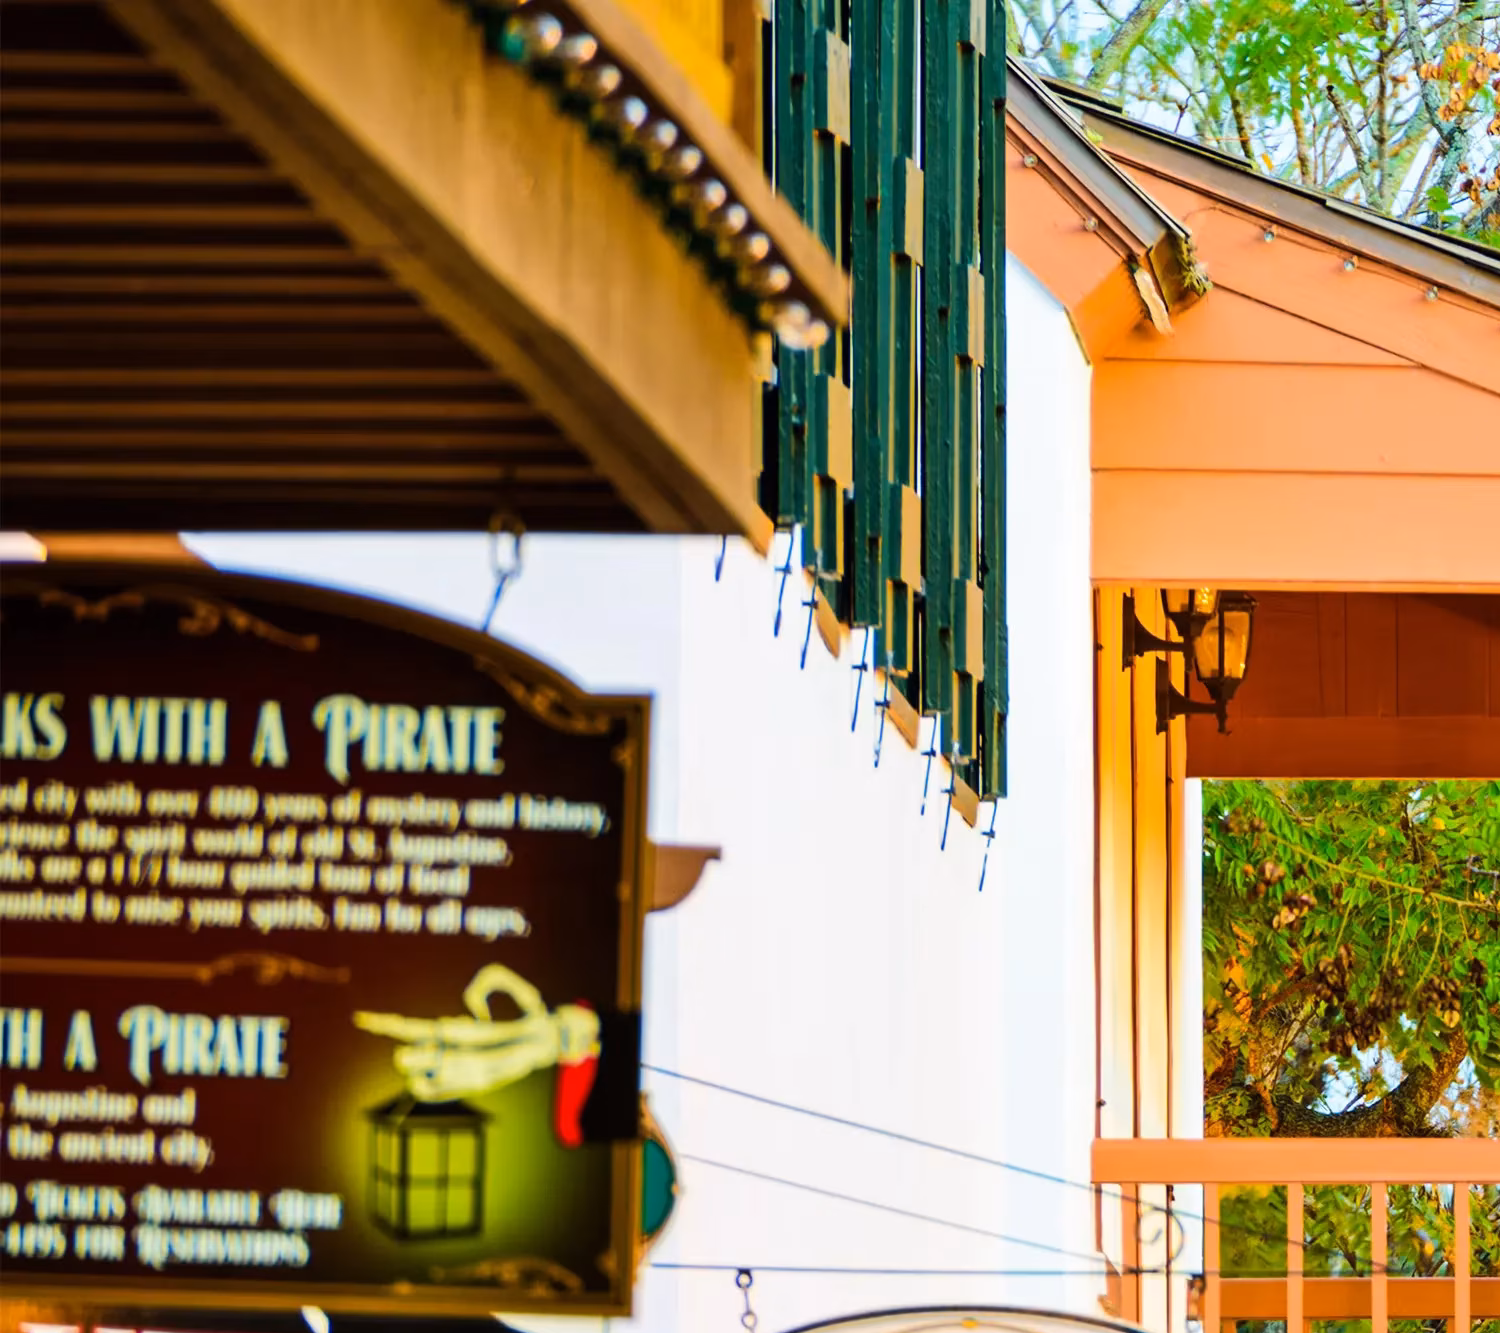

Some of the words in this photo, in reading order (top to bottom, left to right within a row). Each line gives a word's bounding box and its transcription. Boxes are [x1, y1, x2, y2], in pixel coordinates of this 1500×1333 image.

[0, 693, 67, 760] KS
[89, 695, 227, 766] WITH
[252, 700, 289, 768] A
[312, 694, 505, 786] PIRATE
[65, 1010, 97, 1072] A
[118, 1005, 289, 1087] PIRATE
